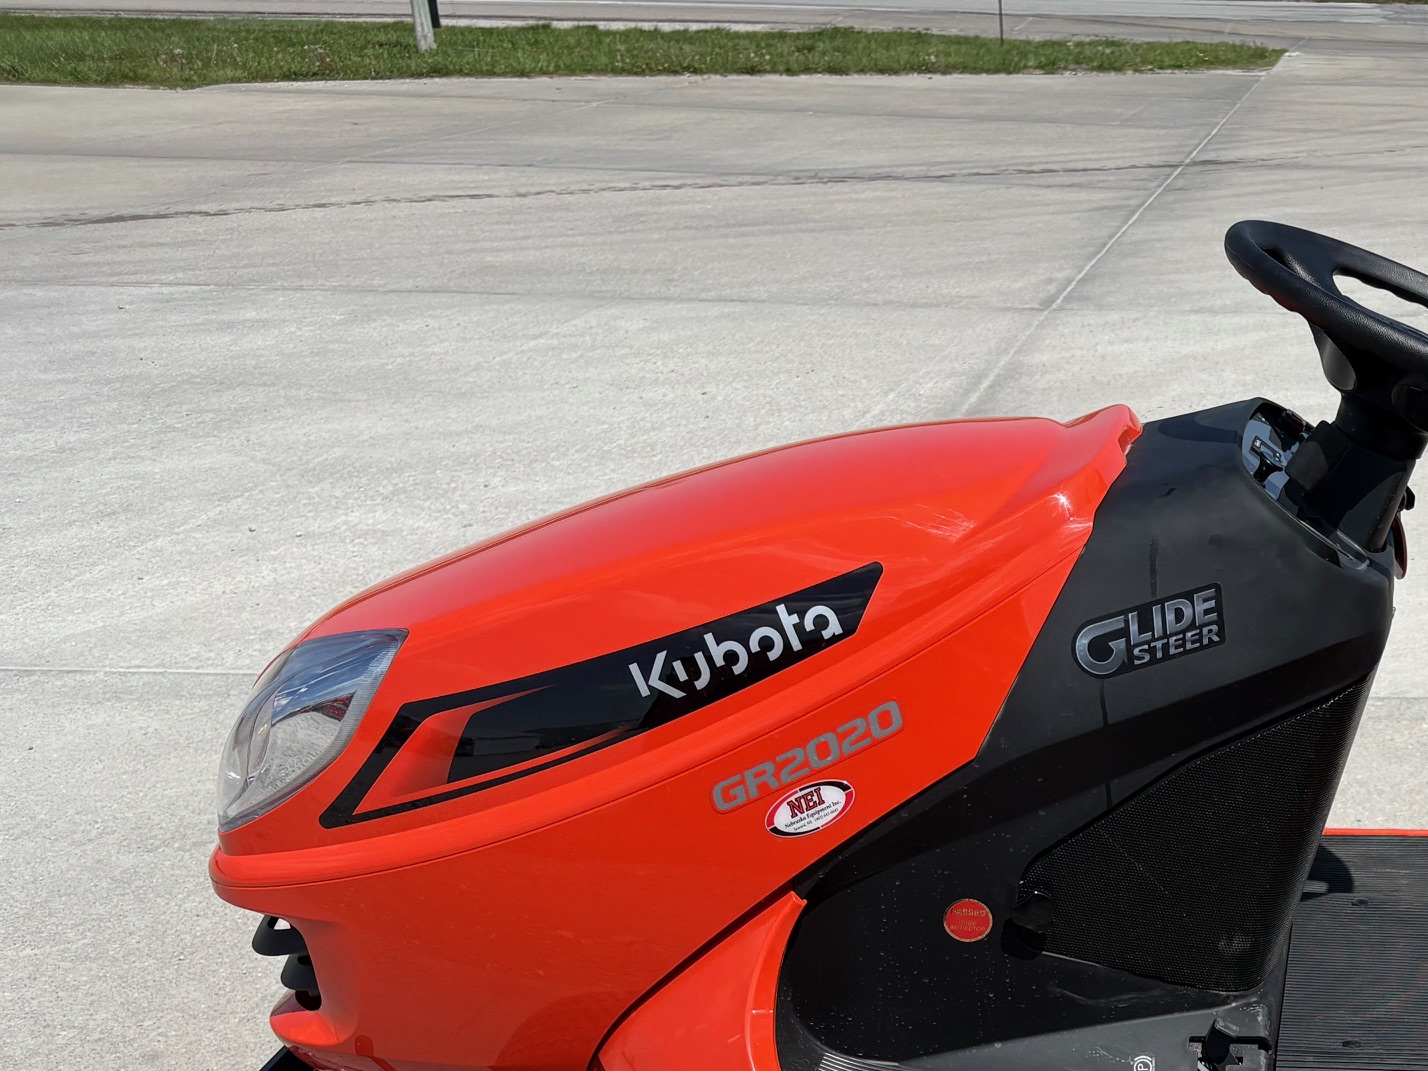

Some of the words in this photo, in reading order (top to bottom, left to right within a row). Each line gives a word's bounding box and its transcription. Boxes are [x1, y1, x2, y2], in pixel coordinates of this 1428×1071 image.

[628, 603, 843, 699] Kubota
[1076, 588, 1219, 675] GLIDE
[1133, 624, 1221, 665] STEER
[711, 700, 904, 813] GR2020
[786, 787, 825, 819] NEI
